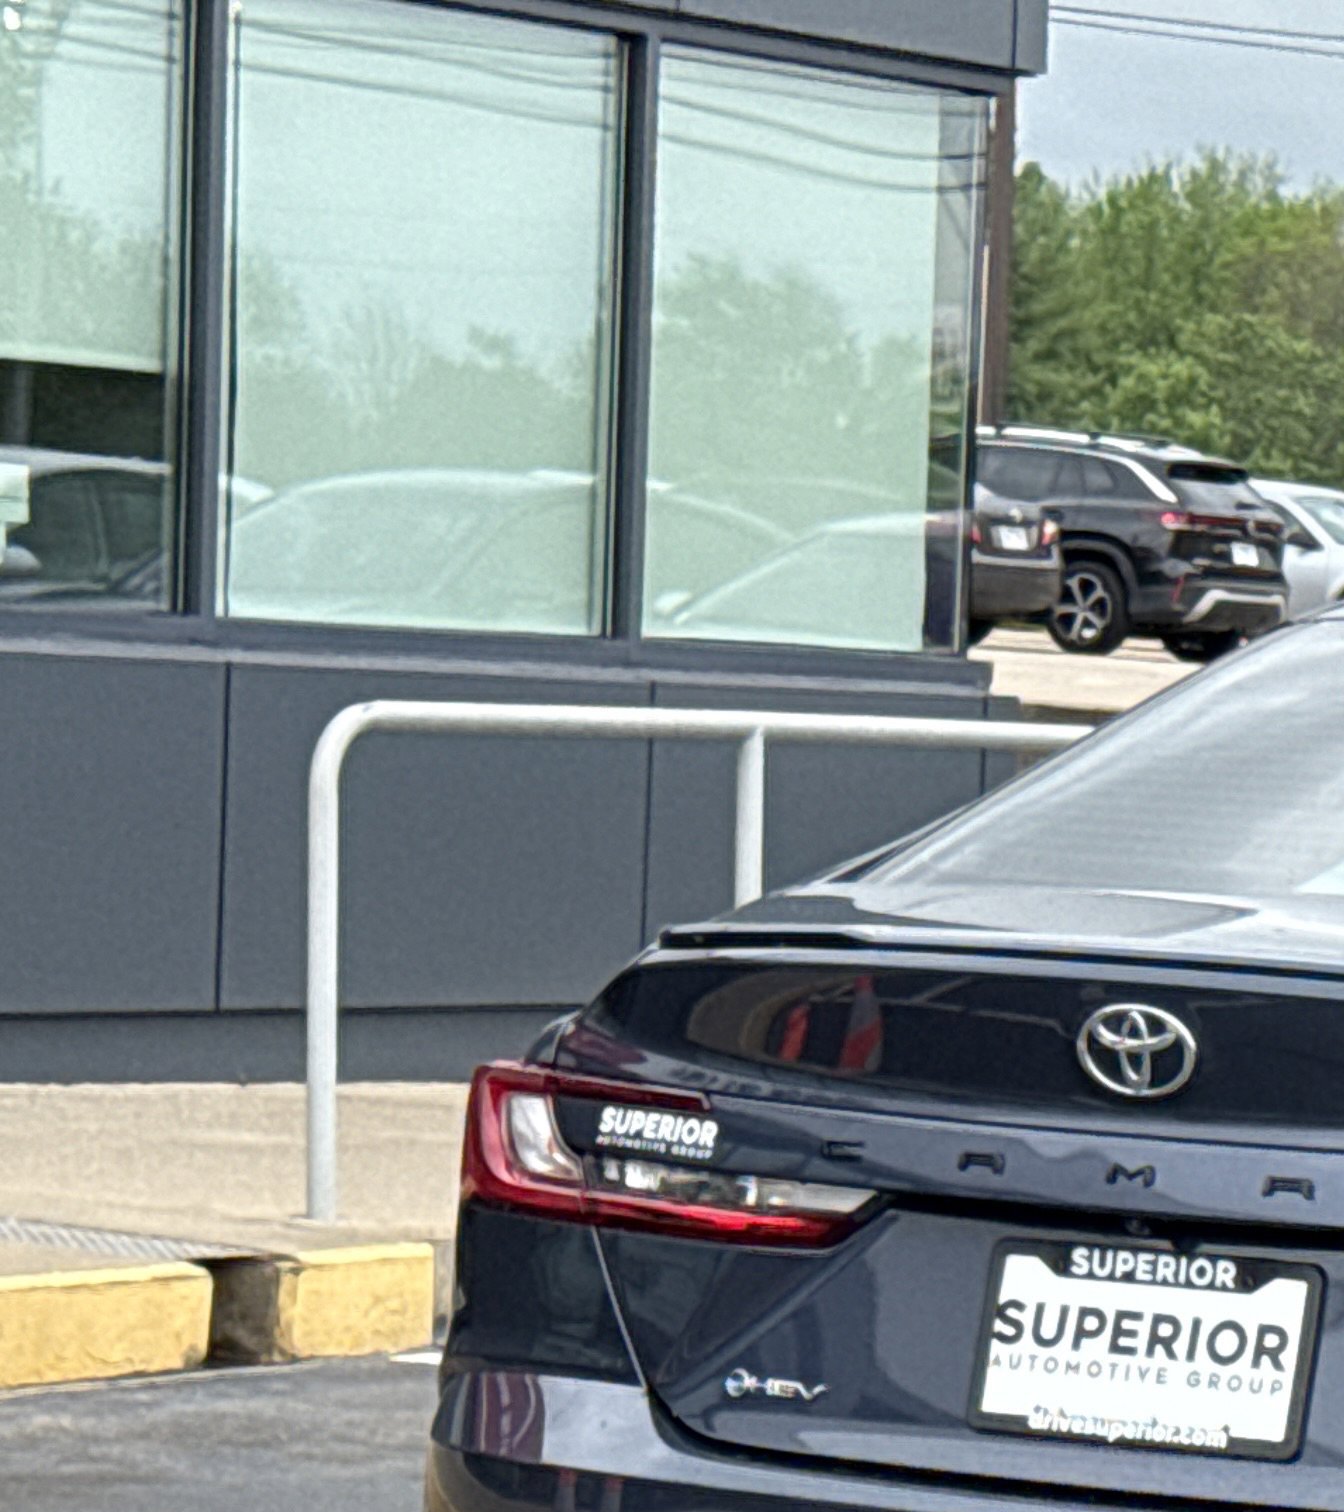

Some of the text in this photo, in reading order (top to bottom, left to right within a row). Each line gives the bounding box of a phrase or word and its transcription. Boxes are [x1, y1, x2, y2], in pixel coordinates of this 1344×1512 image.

[598, 1105, 719, 1149] SUPERIOR
[1070, 1246, 1237, 1289] SUPERIOR
[991, 1298, 1289, 1373] SUPERIOR
[989, 1352, 1284, 1397] AUTOMOTIVE GROUP
